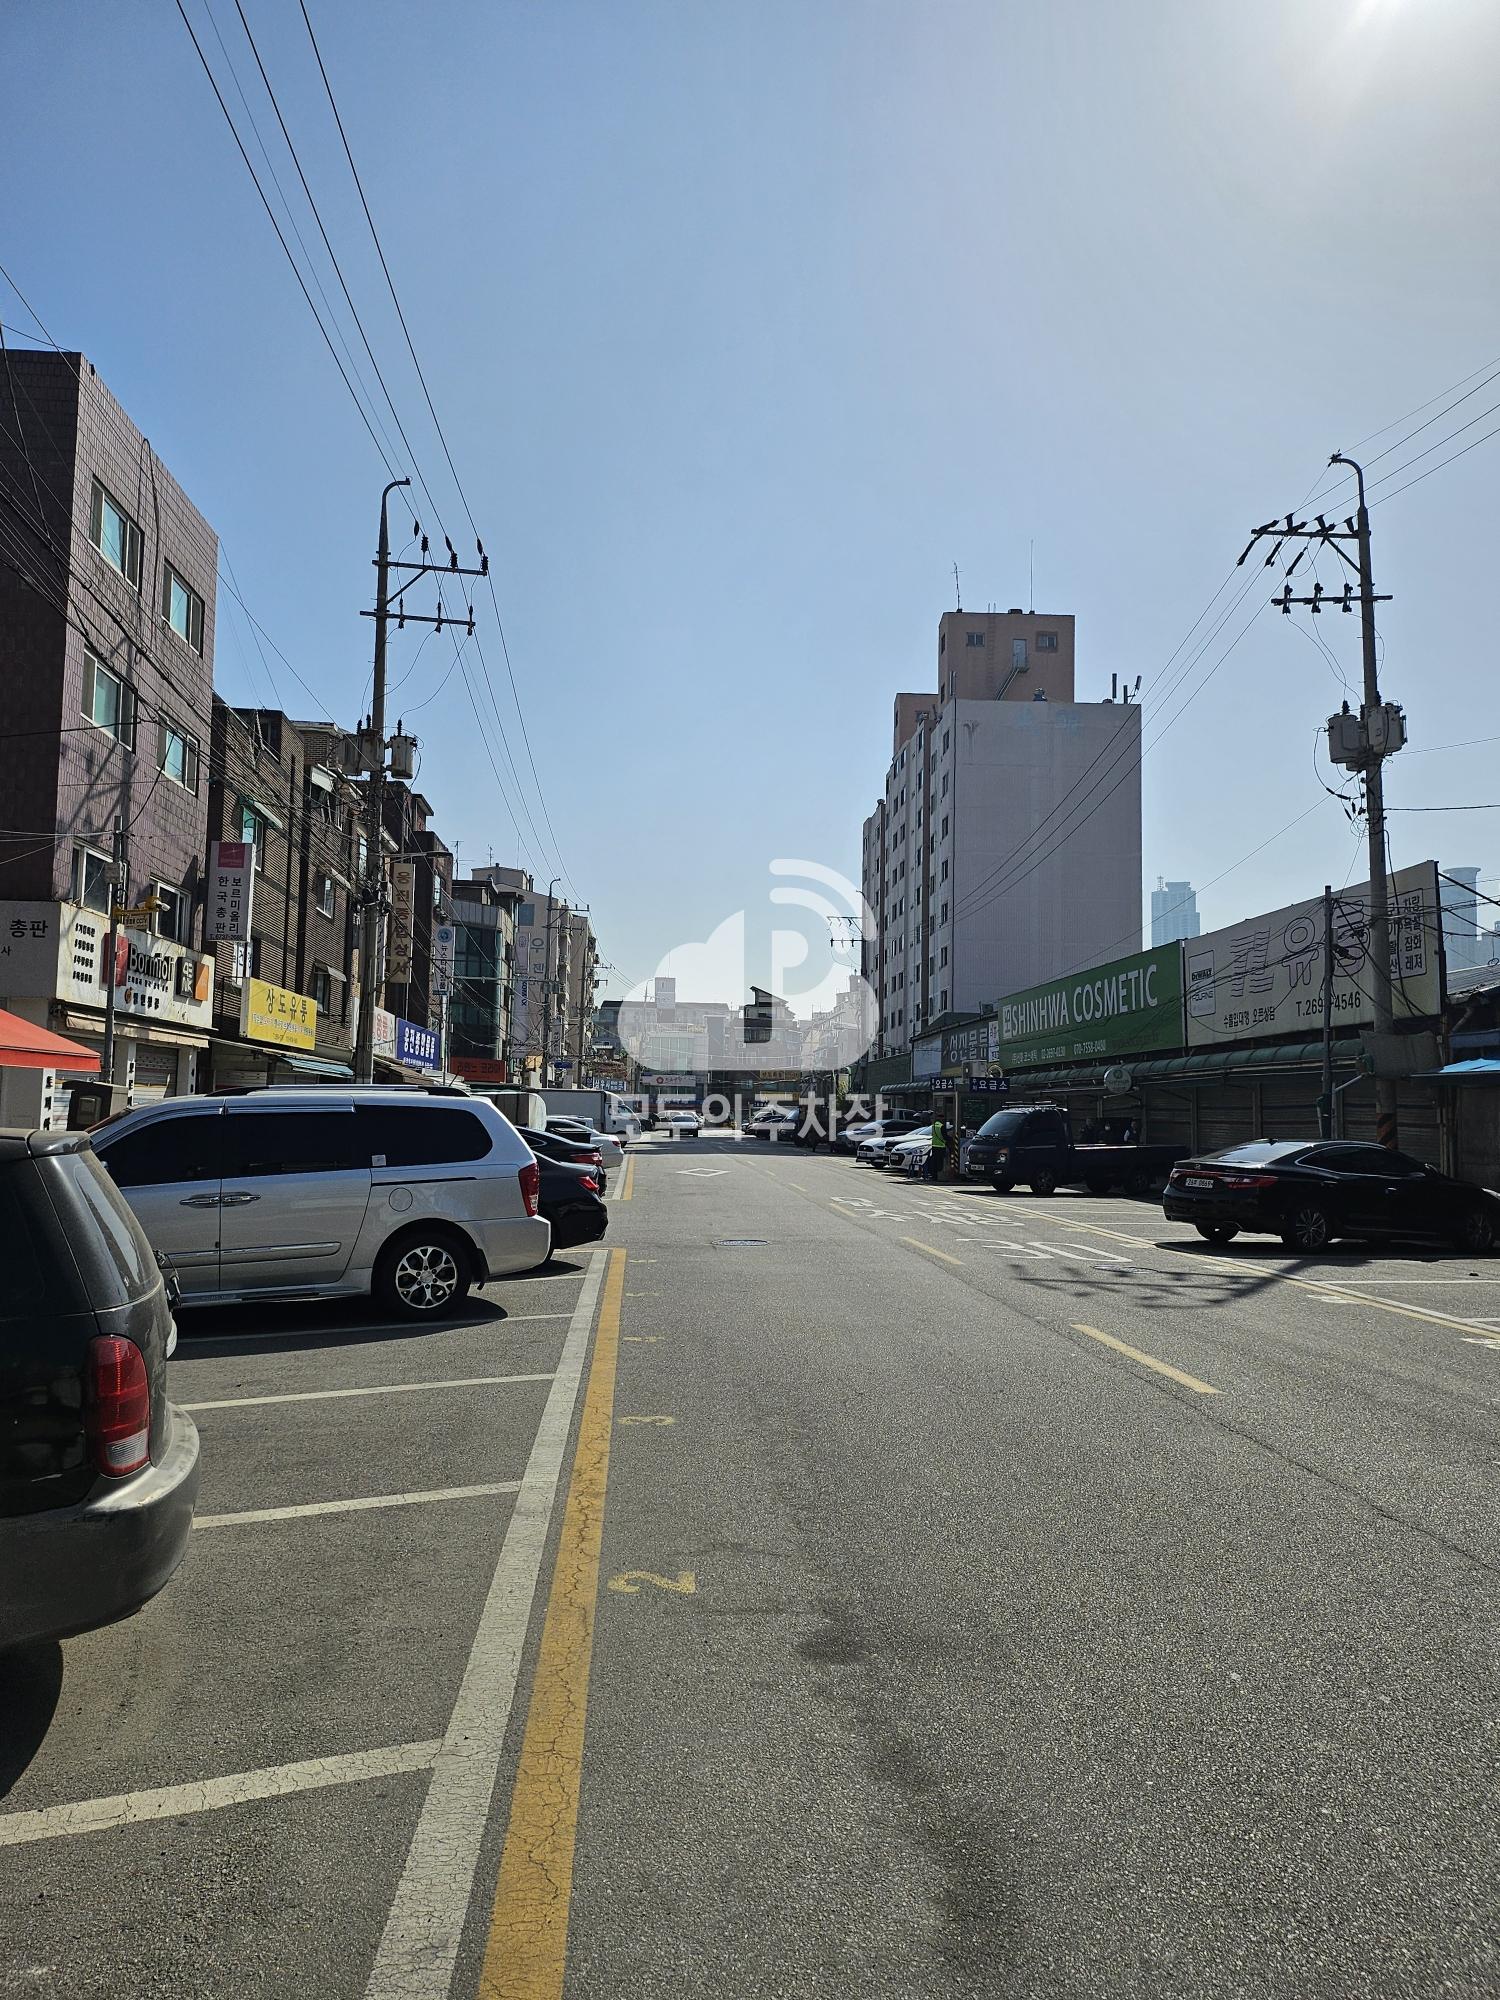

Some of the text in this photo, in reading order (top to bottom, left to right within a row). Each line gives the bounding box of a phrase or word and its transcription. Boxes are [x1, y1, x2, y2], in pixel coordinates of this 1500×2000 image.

[215, 875, 229, 934] 한국총판
[229, 877, 243, 934] 보르미올리
[10, 919, 48, 938] 총판
[129, 943, 176, 982] Bormioli
[266, 988, 308, 1024] 상도유통
[1012, 964, 1158, 1037] SHINHWA COSMETIC
[1295, 990, 1361, 1017] T.269-4546
[935, 1079, 954, 1089] 요금소
[978, 1079, 1009, 1091] 요금소
[956, 1238, 1133, 1262] 30
[606, 1569, 697, 1596] 2
